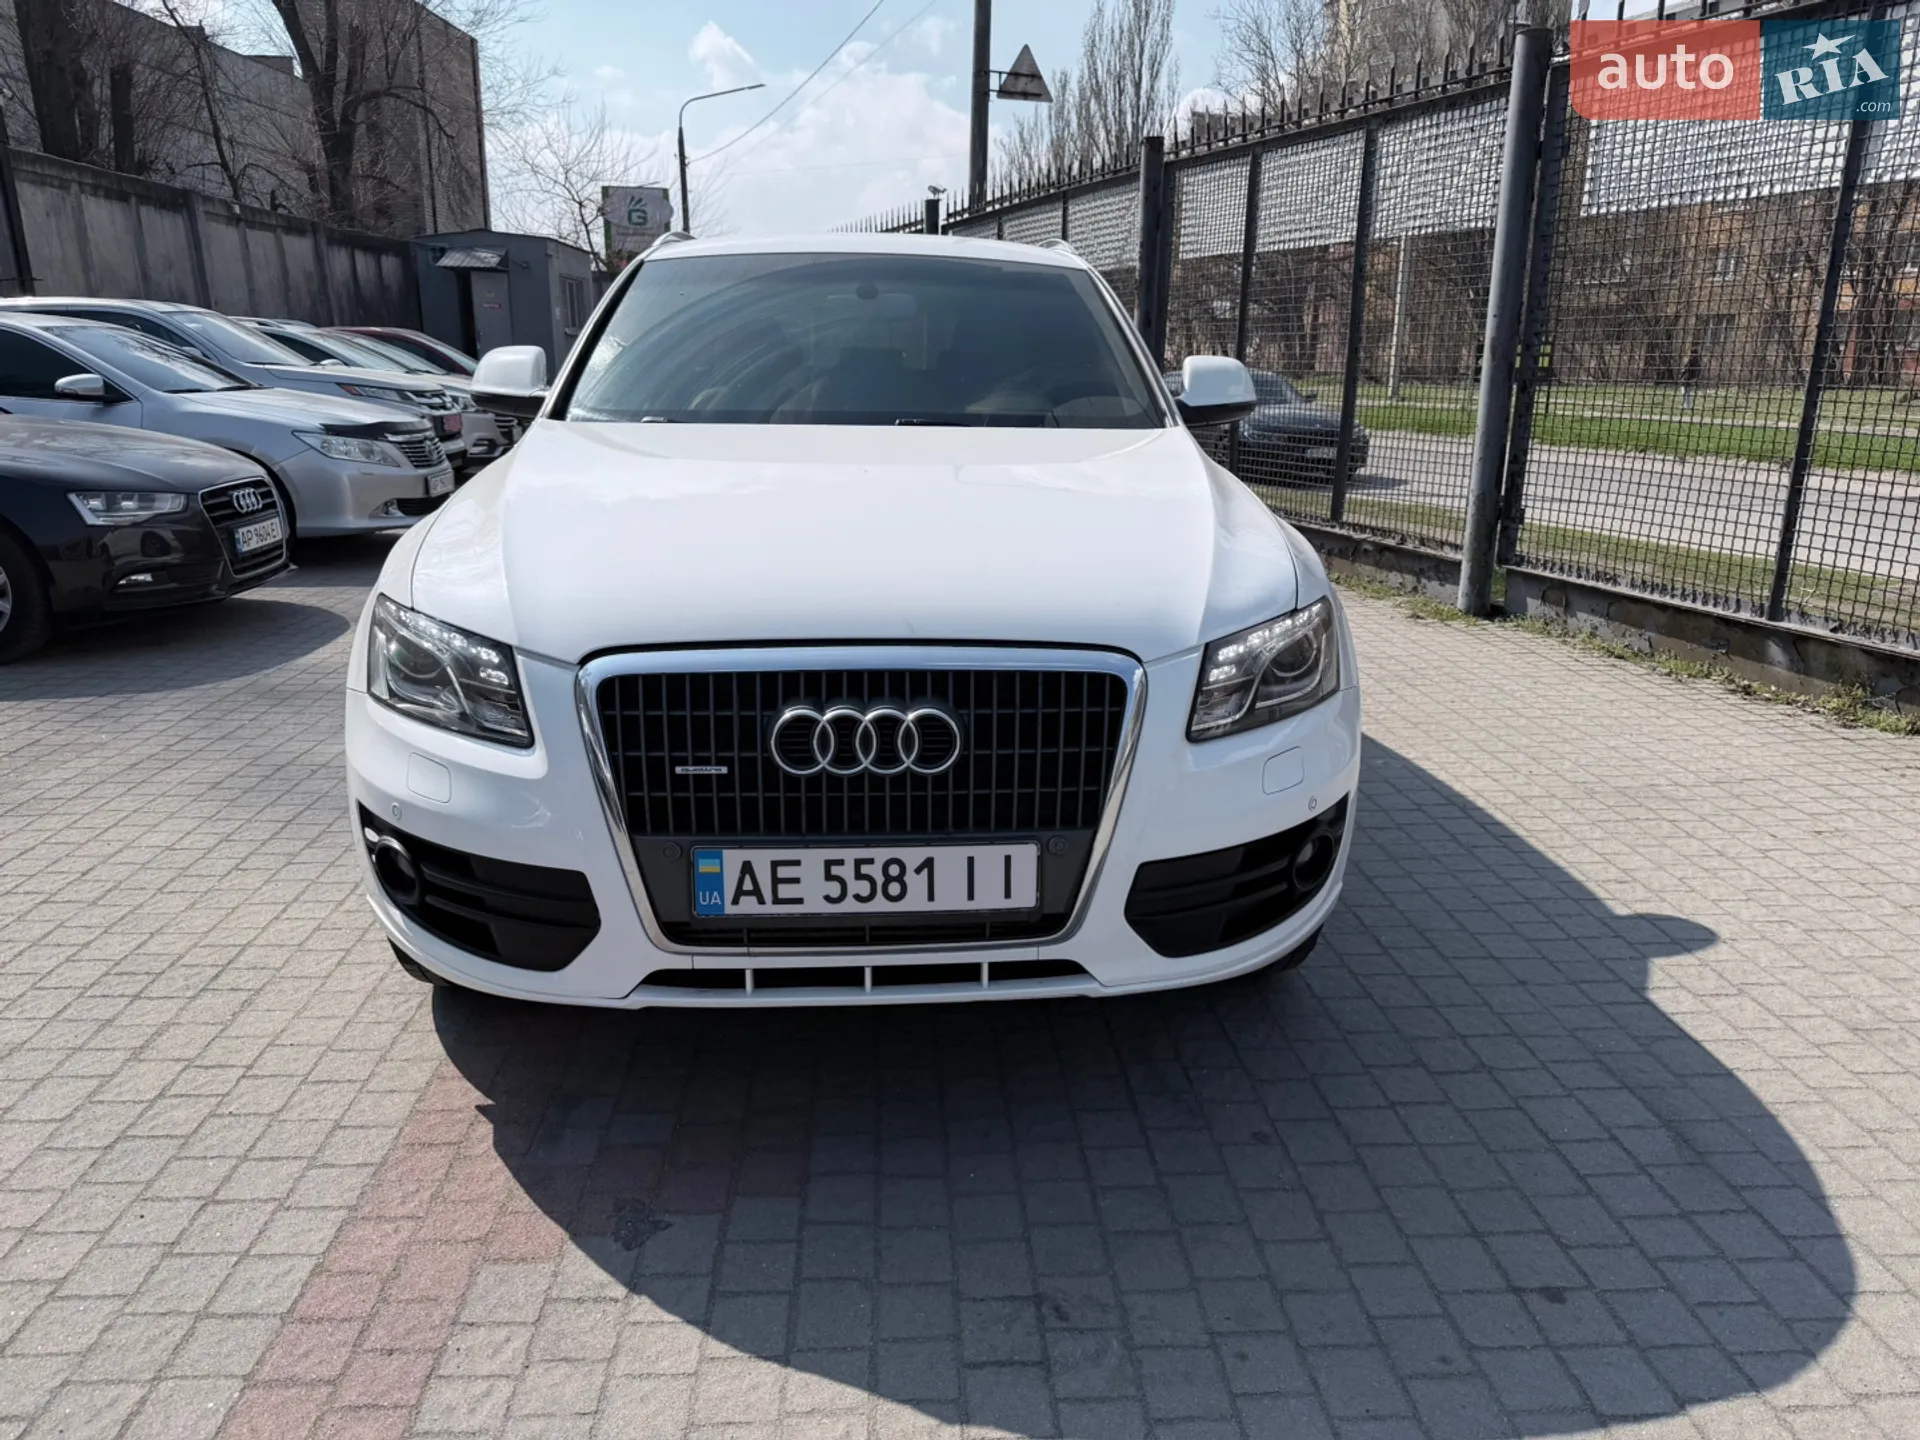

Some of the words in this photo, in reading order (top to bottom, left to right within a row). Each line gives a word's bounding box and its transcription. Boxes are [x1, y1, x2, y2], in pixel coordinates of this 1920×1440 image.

[731, 859, 804, 905] AE
[823, 856, 935, 905] 5581
[699, 890, 722, 905] UA
